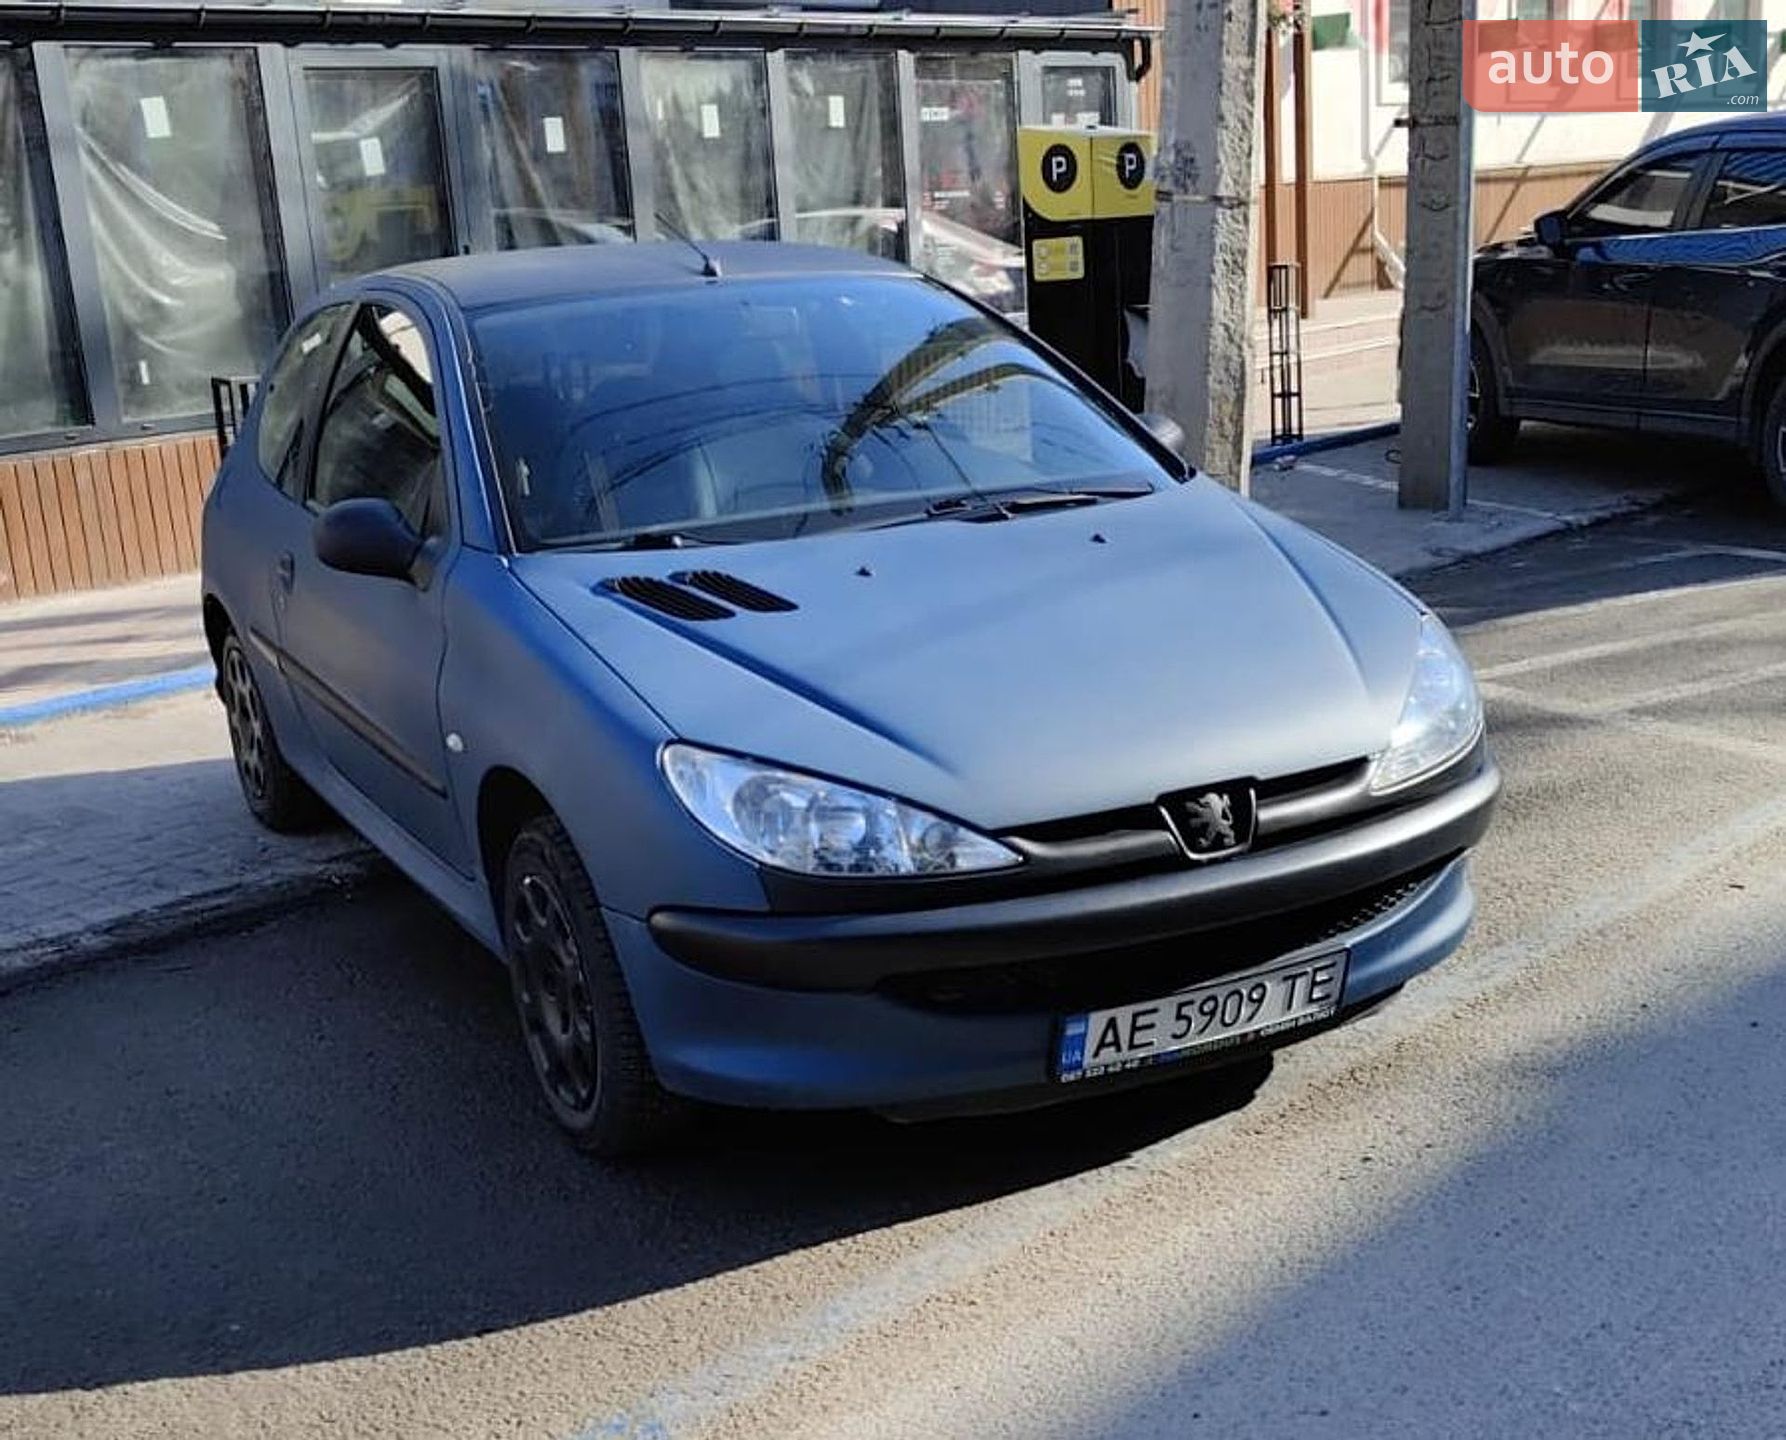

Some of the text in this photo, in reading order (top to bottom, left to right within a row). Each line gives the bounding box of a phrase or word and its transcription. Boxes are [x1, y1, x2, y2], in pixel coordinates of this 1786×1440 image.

[1052, 155, 1067, 182] P
[1123, 152, 1137, 179] P
[1092, 1007, 1159, 1058] AE
[1171, 982, 1267, 1039] 5909
[1282, 961, 1337, 1011] TE
